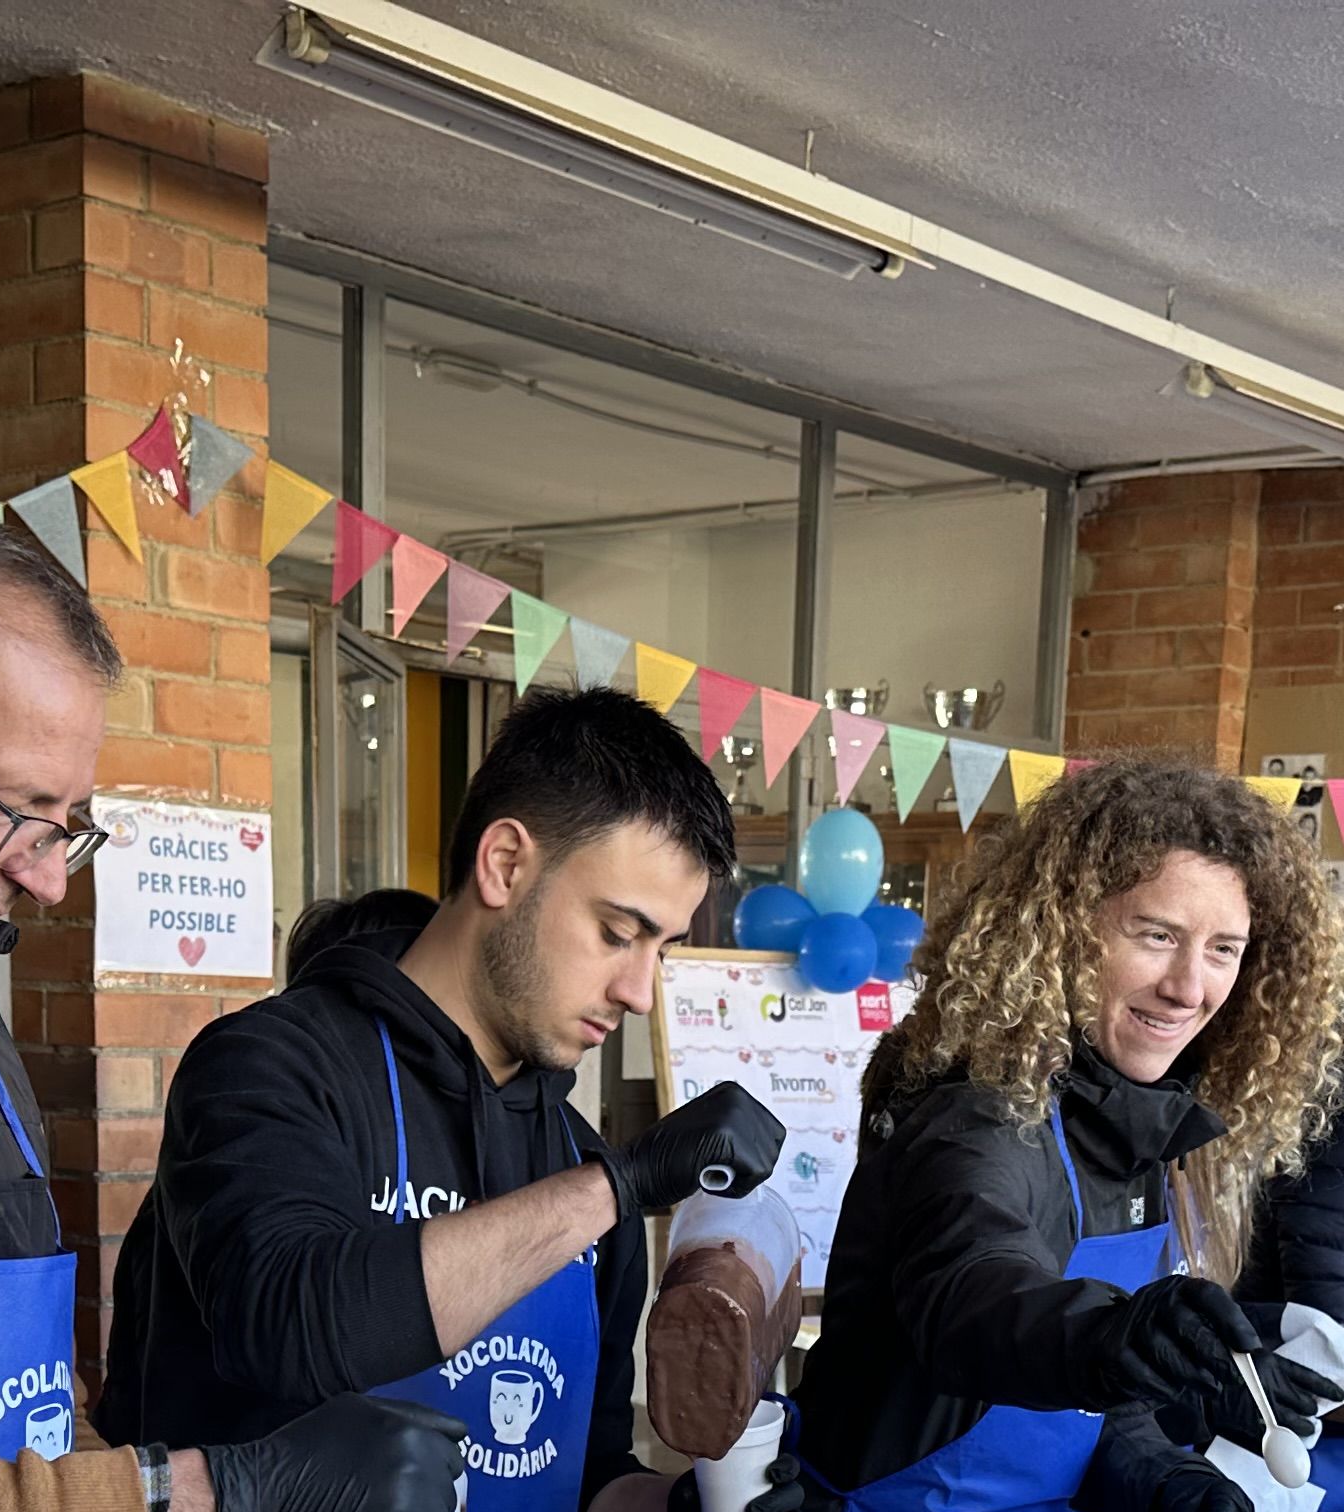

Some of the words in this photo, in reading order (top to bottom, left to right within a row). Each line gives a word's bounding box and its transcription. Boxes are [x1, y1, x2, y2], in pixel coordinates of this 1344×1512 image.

[149, 833, 229, 862] GRÀCIES
[137, 872, 173, 894] PER
[179, 876, 246, 899] FER-HO
[149, 909, 237, 933] POSSIBLE
[439, 1335, 564, 1400] XOCOLATADA
